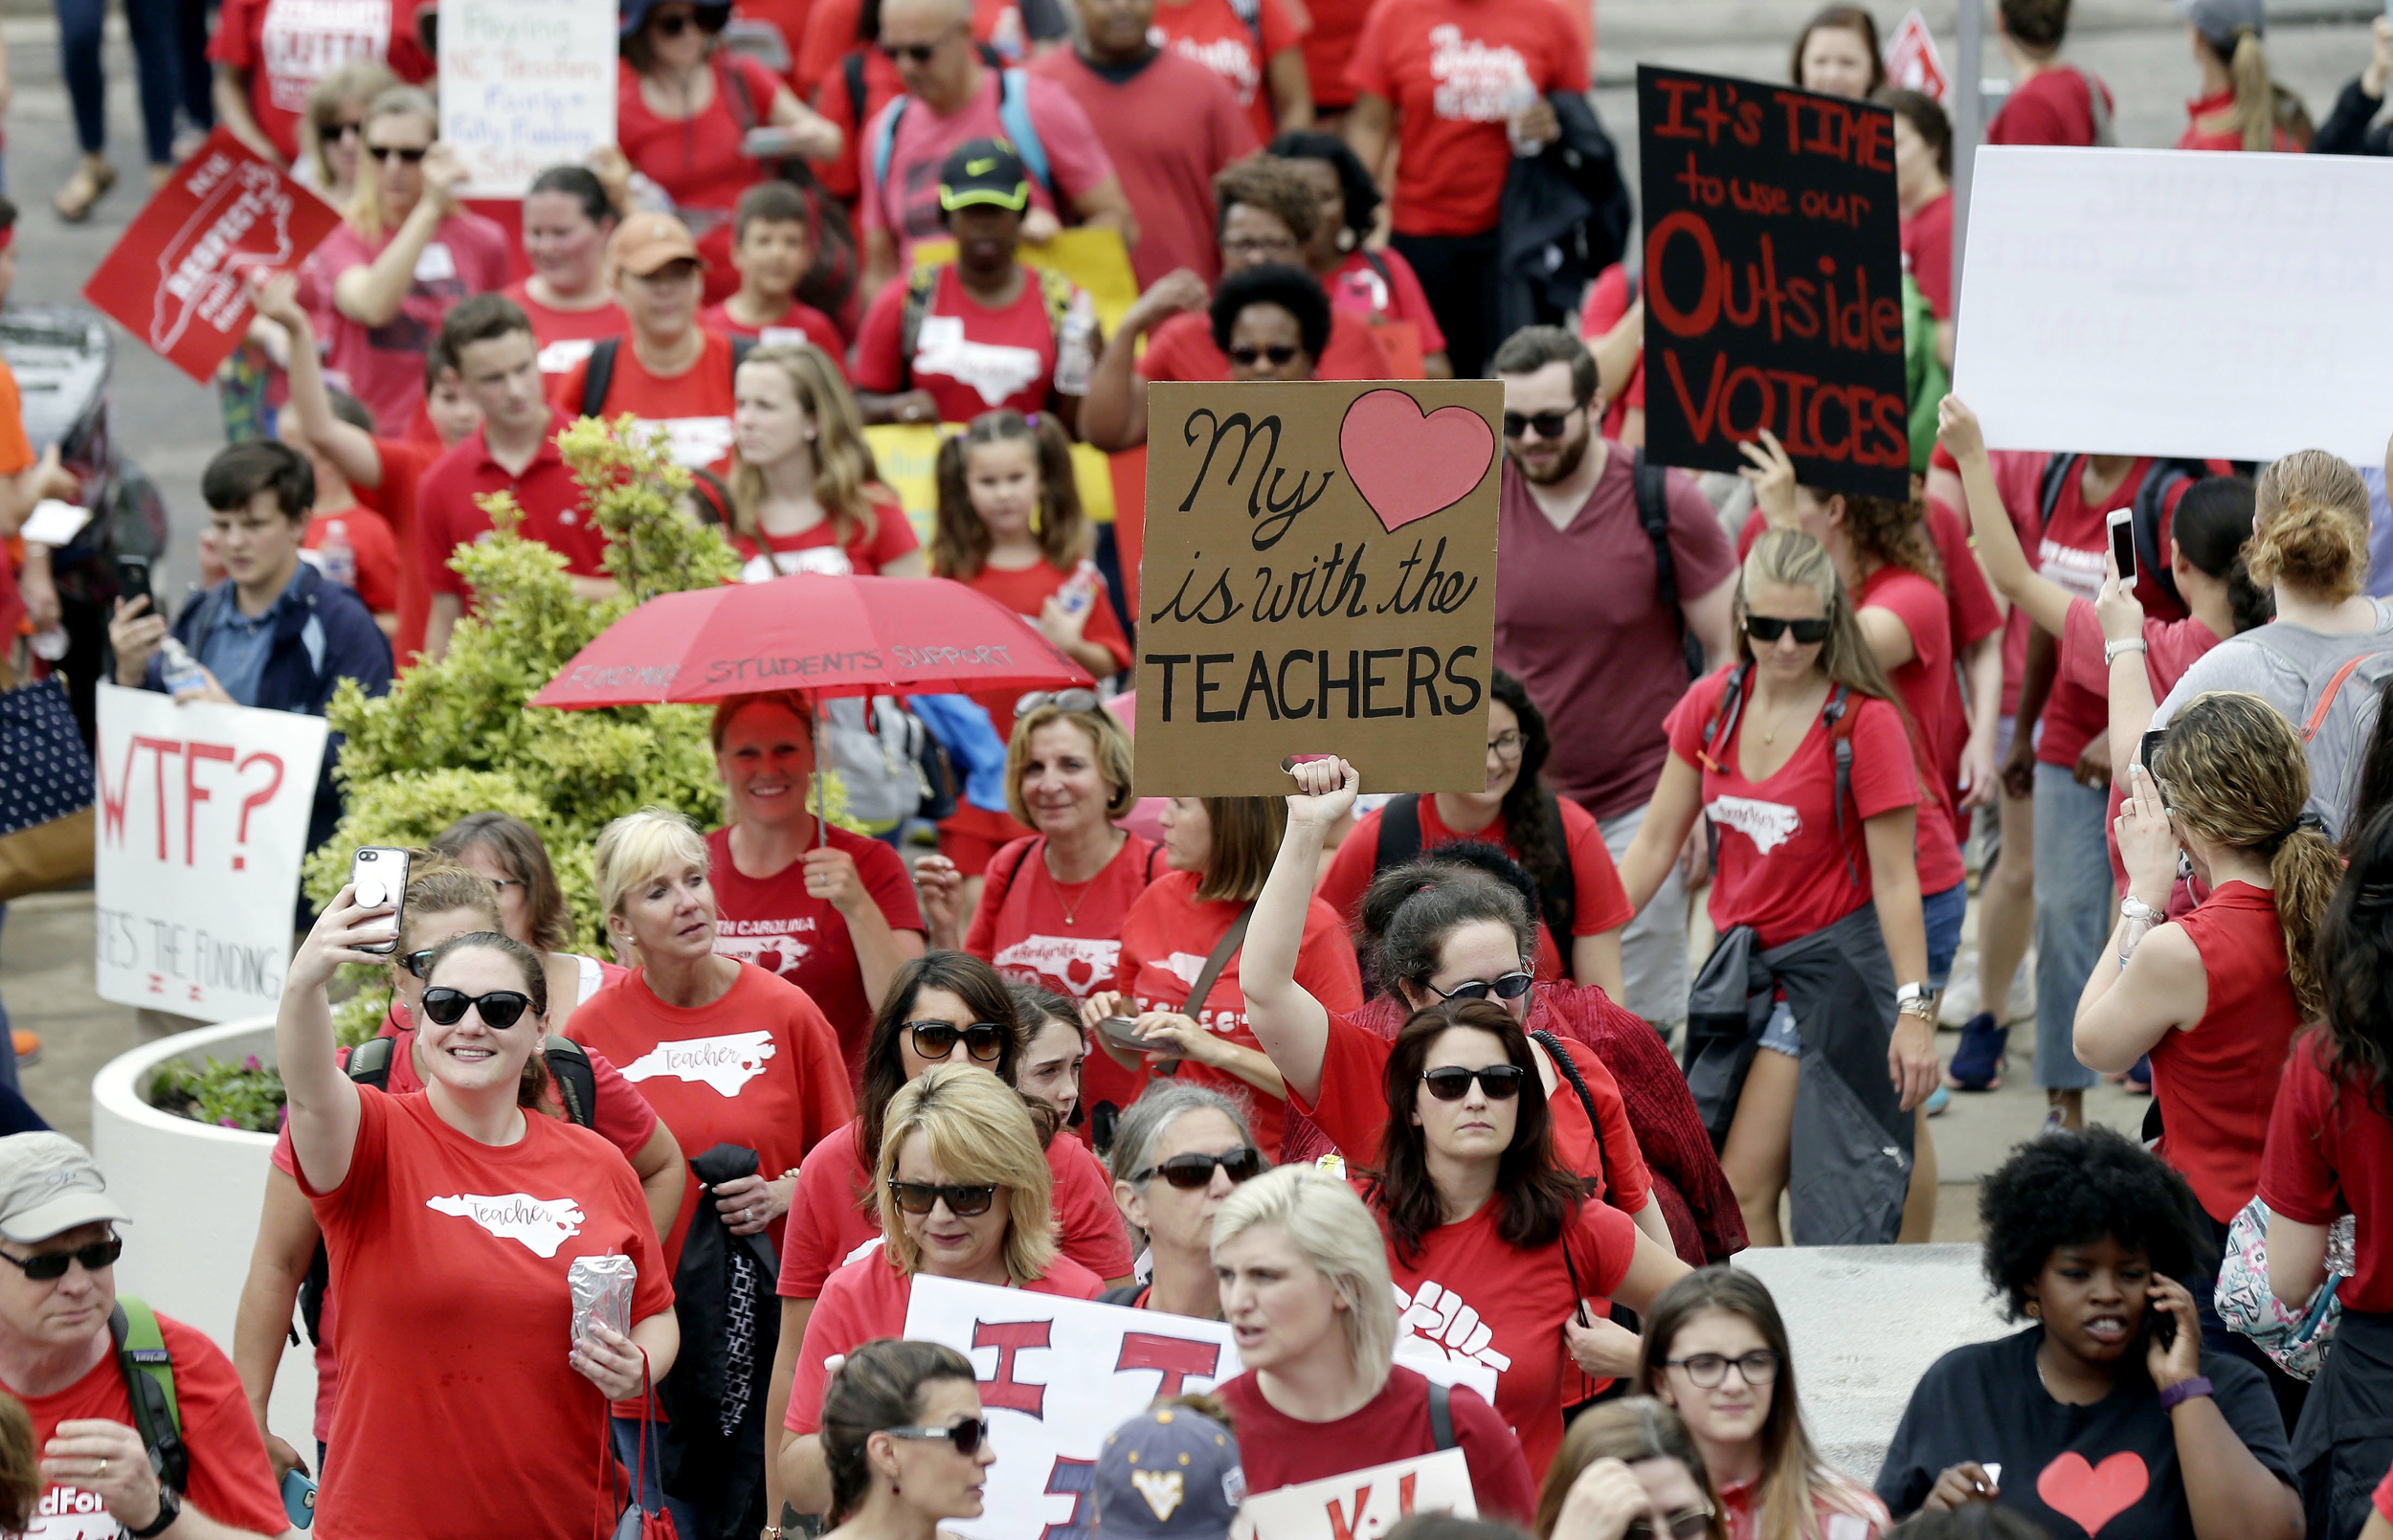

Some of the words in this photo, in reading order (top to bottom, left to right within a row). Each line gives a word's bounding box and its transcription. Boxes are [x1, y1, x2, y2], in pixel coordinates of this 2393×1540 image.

[1653, 78, 1764, 146] It's
[1774, 92, 1894, 164] TIME
[1676, 150, 1725, 208] to
[1730, 177, 1791, 215] use
[1800, 190, 1871, 228] our
[167, 192, 265, 301] RESPECT
[1644, 210, 1905, 354] Outside
[1663, 348, 1911, 469] VOICES
[1178, 409, 1334, 551] My
[1152, 551, 1243, 624] is
[1251, 542, 1367, 623] with
[1375, 536, 1479, 614] the
[704, 649, 883, 683] STUDENTS
[891, 644, 1017, 668] SUPPORT
[1145, 645, 1482, 723] TEACHERS
[96, 723, 285, 872] WTF?
[145, 917, 189, 980] THE
[737, 917, 816, 936] CAROLINA
[661, 1042, 741, 1072] Teacher
[468, 1198, 553, 1226] Teacher
